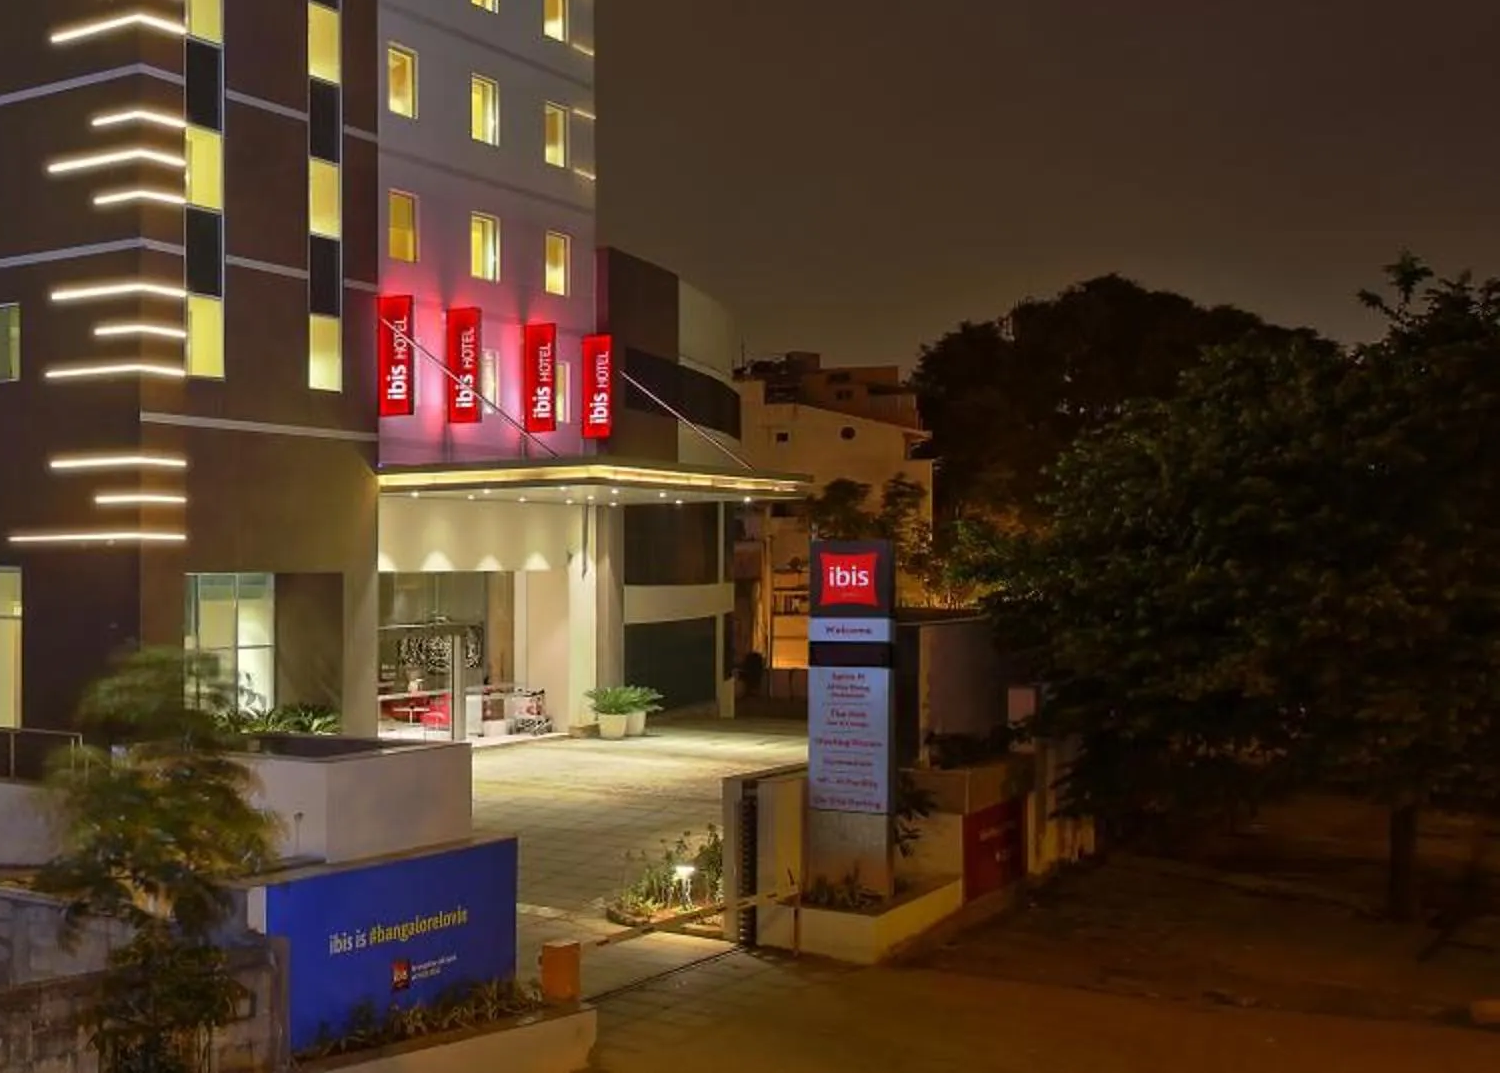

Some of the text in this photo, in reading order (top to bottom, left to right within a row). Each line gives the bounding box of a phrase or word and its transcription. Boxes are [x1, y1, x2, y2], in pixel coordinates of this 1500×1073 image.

[386, 364, 407, 400] ibis
[455, 327, 476, 408] ibis HOTEL
[532, 342, 552, 419] ibis HOTEL
[589, 351, 610, 425] ibis HOTEL
[829, 566, 869, 587] ibis
[329, 932, 353, 956] ibis
[355, 929, 366, 948] is
